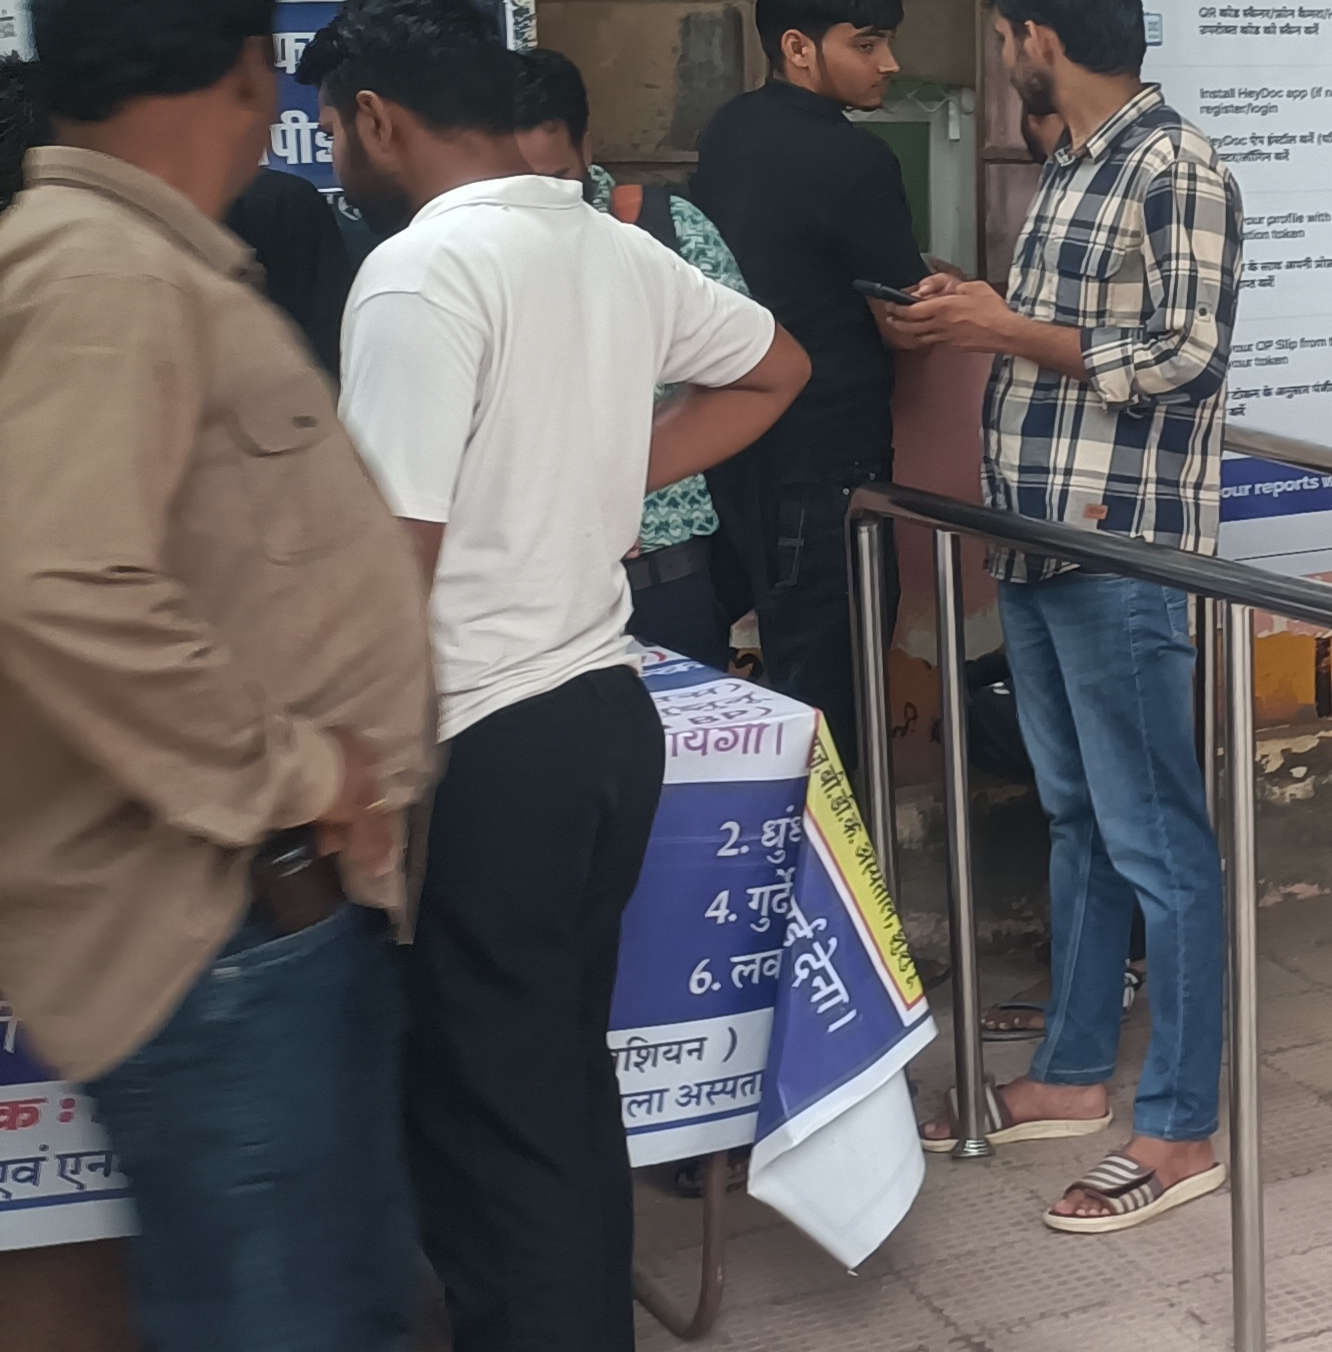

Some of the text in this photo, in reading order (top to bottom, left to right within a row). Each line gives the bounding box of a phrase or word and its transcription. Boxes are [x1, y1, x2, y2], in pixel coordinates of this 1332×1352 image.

[1199, 6, 1216, 18] QR
[1200, 88, 1236, 98] Install
[1238, 88, 1284, 101] HeyDoc
[1286, 89, 1308, 101] app
[1245, 216, 1266, 226] our
[1307, 211, 1332, 224] with
[1231, 344, 1254, 354] our
[1299, 337, 1328, 349] from
[1220, 475, 1319, 498] our reports
[666, 721, 785, 758] ायगा।
[716, 820, 750, 857] 2.
[704, 889, 738, 925] 4.
[688, 958, 722, 995] 6.
[675, 1073, 763, 1110] अस्पता
